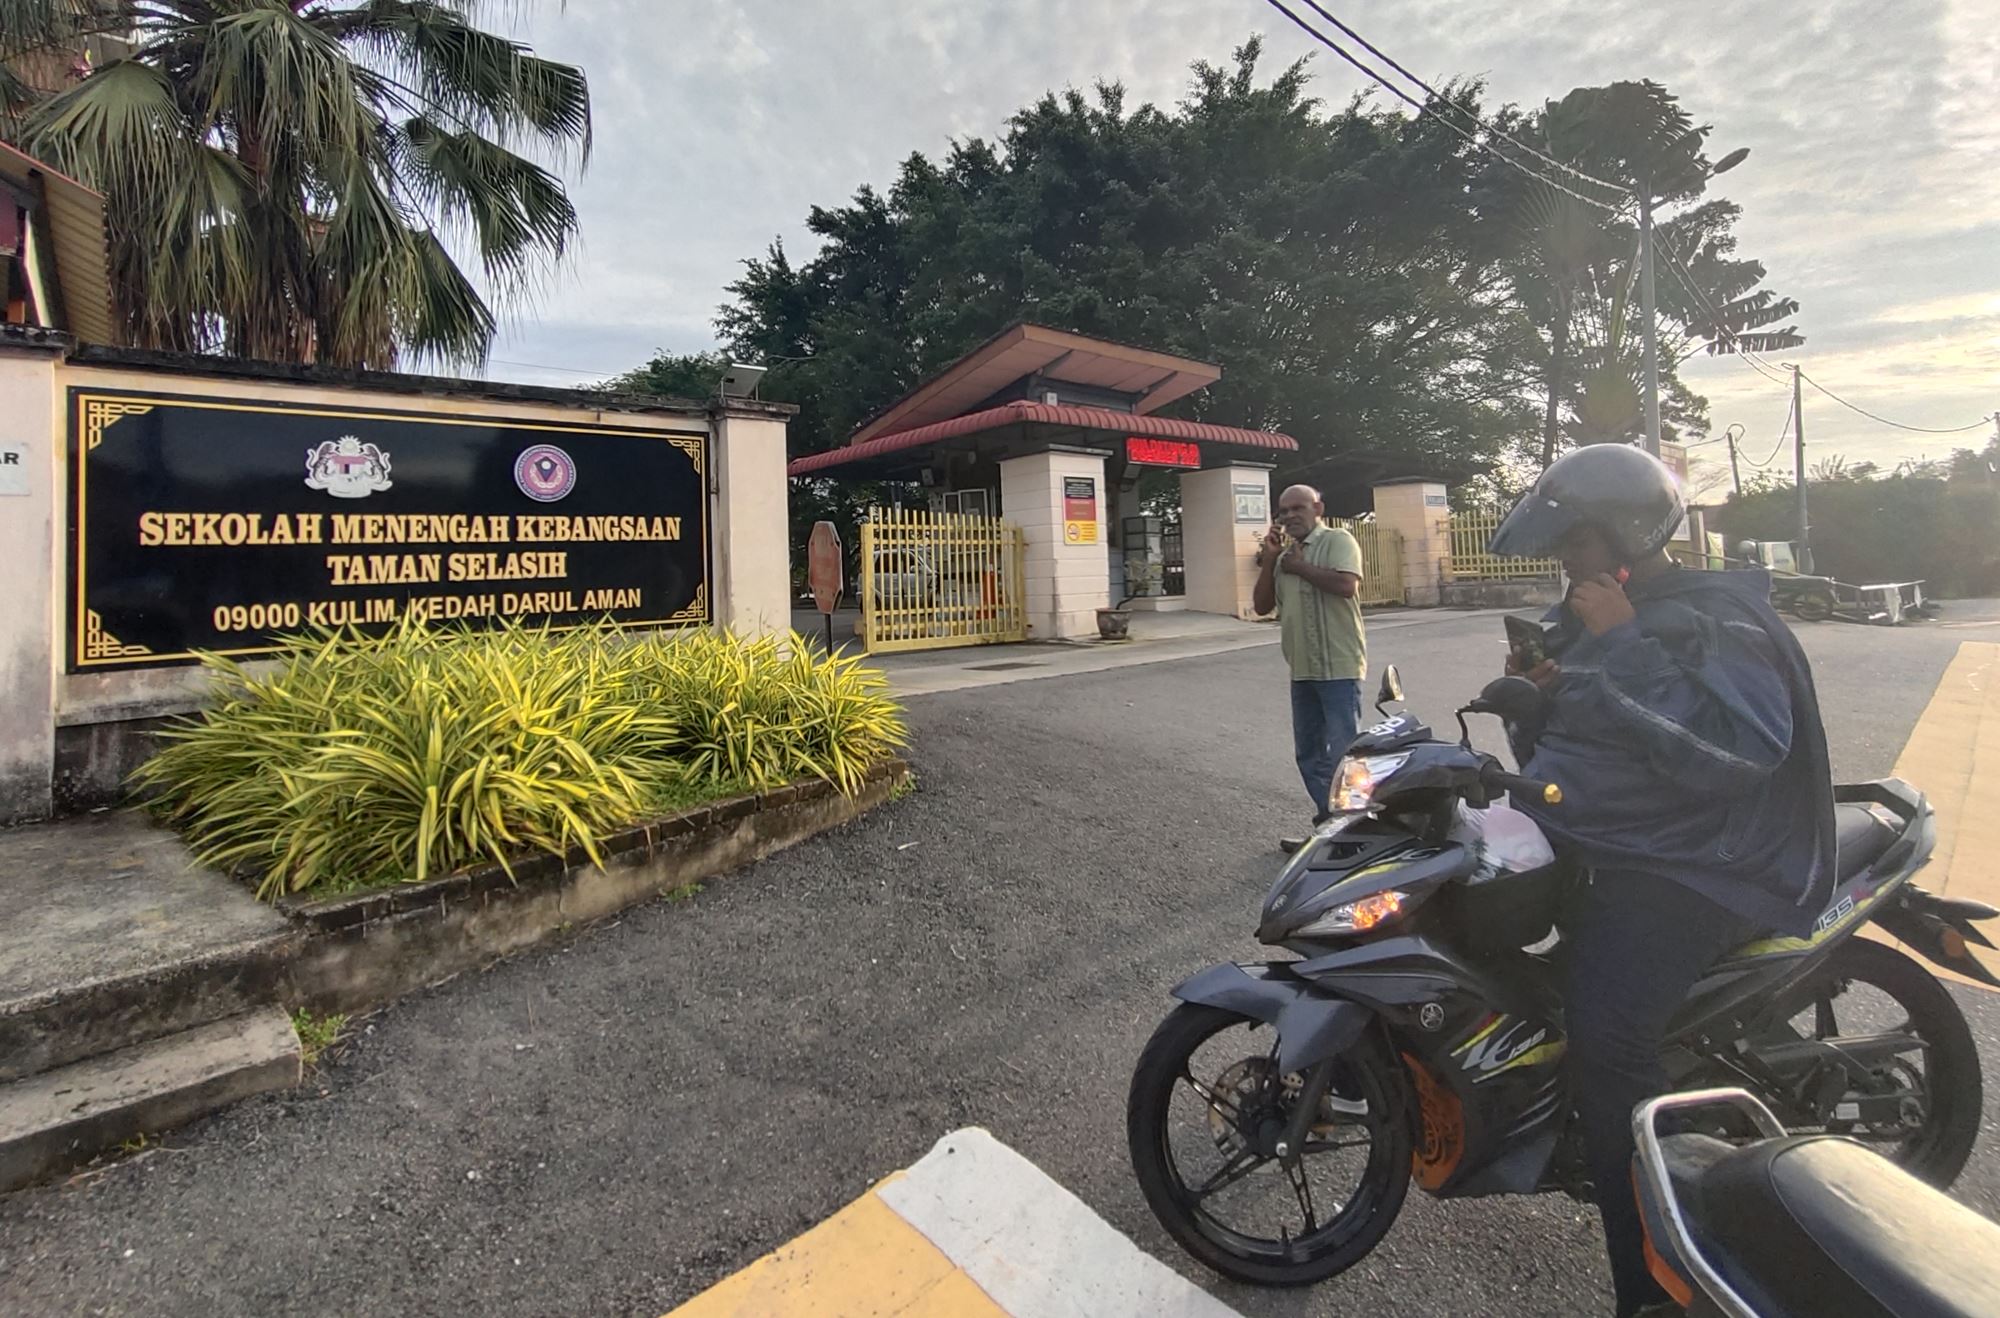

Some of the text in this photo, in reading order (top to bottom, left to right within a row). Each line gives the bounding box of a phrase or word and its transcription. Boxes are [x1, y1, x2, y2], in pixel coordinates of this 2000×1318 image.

[139, 511, 681, 547] SEKOLAH MENENGAH KEBANGSAAN
[327, 551, 568, 586] TAMAN SELASIH
[213, 602, 300, 632] 09000
[411, 592, 495, 620] KEDAH
[502, 590, 578, 616] DARUL
[583, 587, 642, 610] AMAN
[1817, 895, 1855, 932] 135
